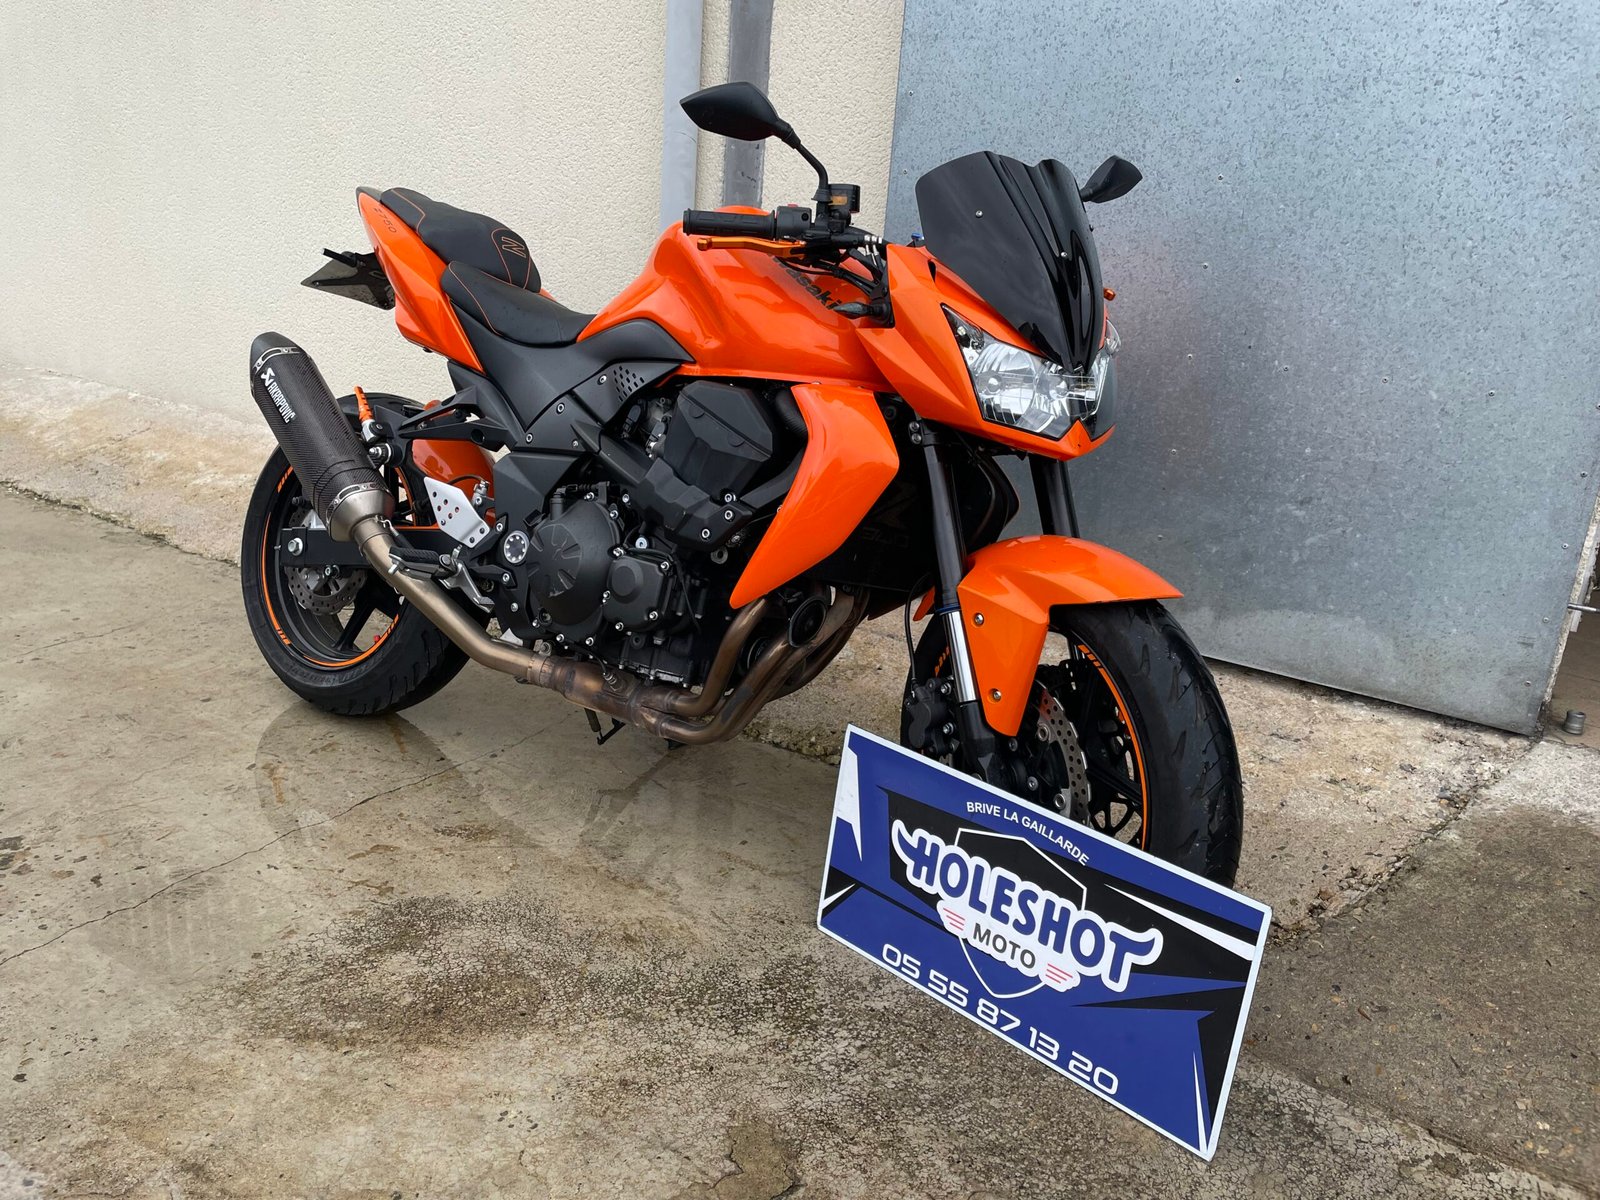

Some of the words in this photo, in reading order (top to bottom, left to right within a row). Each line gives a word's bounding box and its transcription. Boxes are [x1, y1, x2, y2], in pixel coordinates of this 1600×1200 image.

[966, 801, 1001, 817] BRIVE
[1003, 808, 1019, 824] LA
[1021, 816, 1090, 866] GAILLARDE
[896, 826, 1157, 984] HOLESHOT
[973, 923, 1036, 969] MOTO
[882, 943, 921, 980] 05
[928, 968, 969, 1007] 55
[976, 998, 1021, 1032] 87
[1029, 1026, 1060, 1061] 13
[1068, 1050, 1119, 1095] 20
